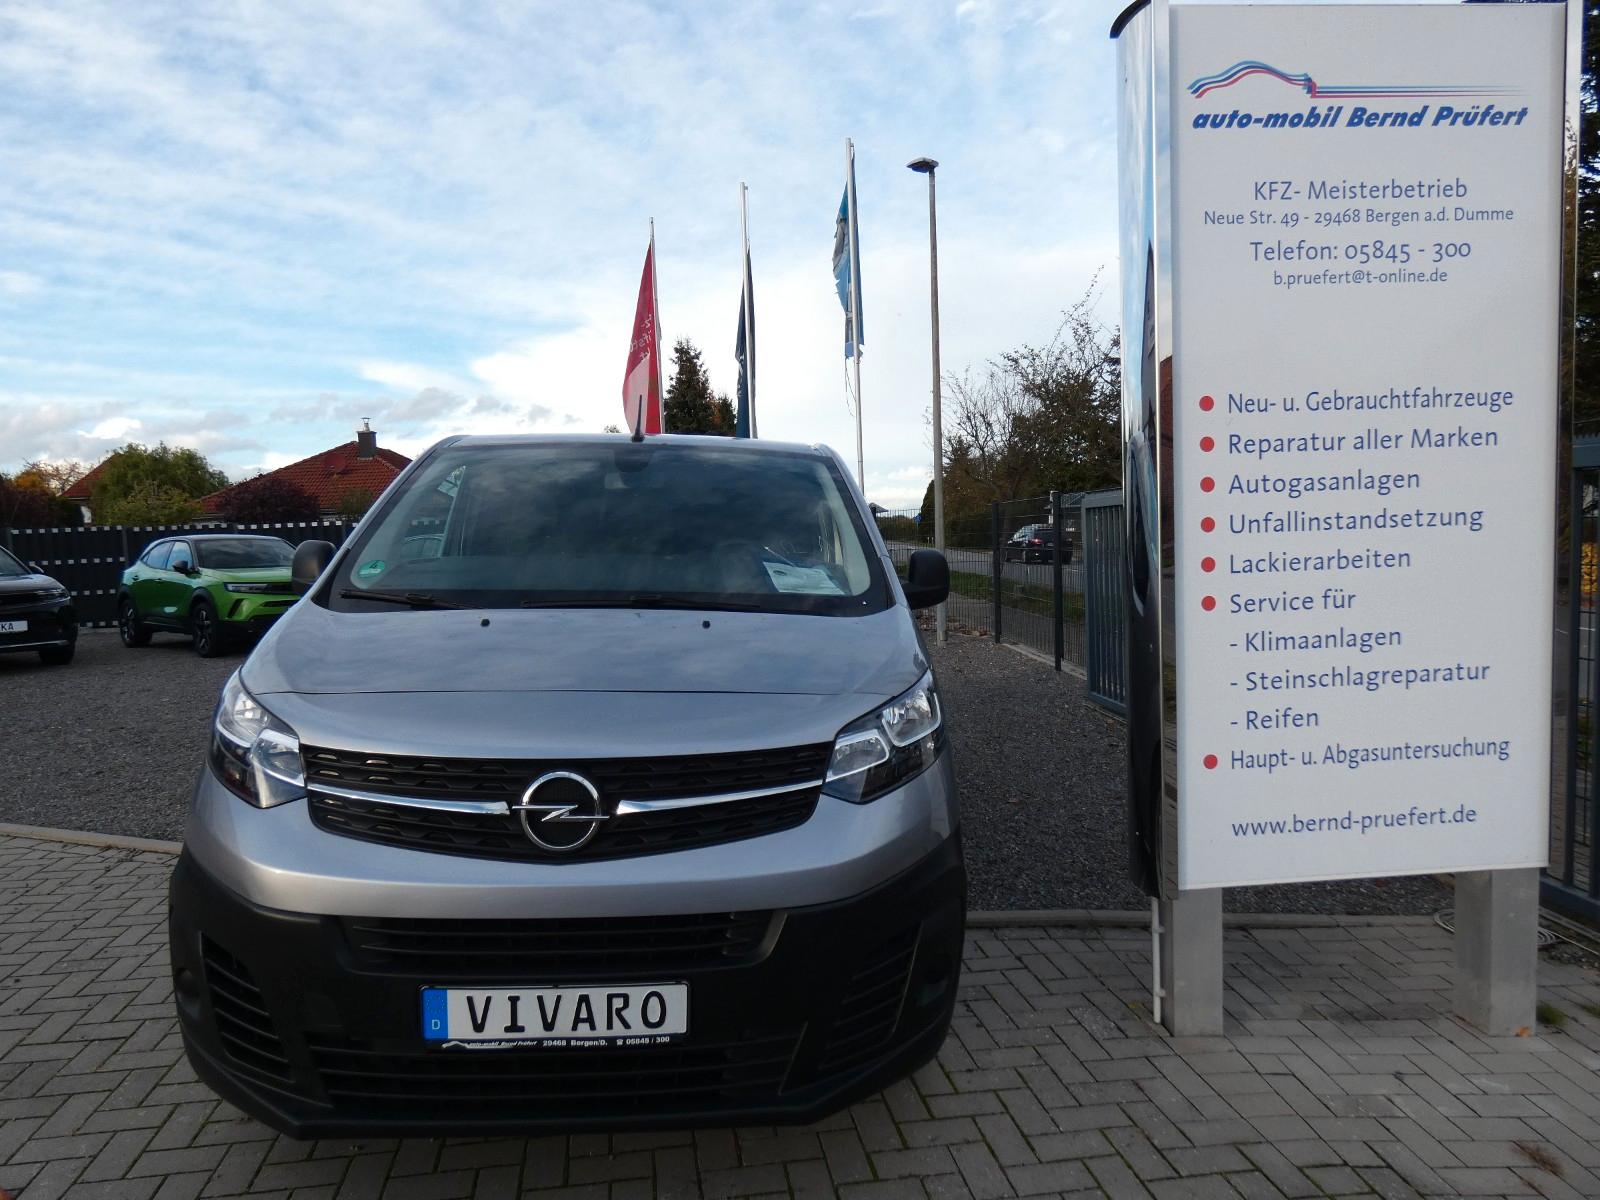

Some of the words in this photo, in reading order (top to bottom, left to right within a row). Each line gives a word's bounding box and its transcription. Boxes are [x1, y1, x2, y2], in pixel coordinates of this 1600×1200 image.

[1192, 106, 1343, 129] auto-mobil
[1346, 105, 1429, 128] Bernd
[1432, 104, 1529, 127] Prüfert
[1254, 181, 1301, 201] KFZ-
[1308, 178, 1468, 200] Meisterbetrieb
[1204, 210, 1245, 225] Neue
[1250, 210, 1277, 225] Str.
[1280, 212, 1300, 228] 49
[1314, 208, 1361, 228] 29468
[1366, 209, 1419, 226] Bergen
[1424, 207, 1450, 222] a.d.
[1454, 207, 1514, 222] Dumme
[1250, 240, 1339, 262] Telefon:
[1344, 240, 1411, 265] 05845
[1432, 242, 1472, 262] 300
[1273, 268, 1449, 290] b.pruefert@t-online.de
[1229, 393, 1277, 414] Neu-
[1283, 397, 1300, 412] u.
[1305, 387, 1514, 414] Gebrauchtfahrzeuge
[1229, 432, 1346, 460] Reparatur
[1353, 428, 1403, 451] aller
[1411, 426, 1498, 449] Marken
[1229, 469, 1420, 499] Autogasanlagen
[1229, 508, 1485, 534] Unfallinstandsetzung
[1230, 549, 1411, 575] Lackierarbeiten
[1230, 590, 1314, 614] Service
[1321, 588, 1357, 610] für
[1245, 627, 1402, 654] Klimaanlagen
[1245, 663, 1490, 692] Steinschlagreparatur
[1245, 707, 1319, 731] Reifen
[1231, 748, 1296, 774] Haupt-
[1301, 751, 1318, 766] u.
[1322, 737, 1510, 768] Abgasuntersuchung
[1232, 804, 1477, 837] www.bernd-pruefert.de
[432, 1019, 441, 1030] D
[466, 990, 667, 1034] VIVARO
